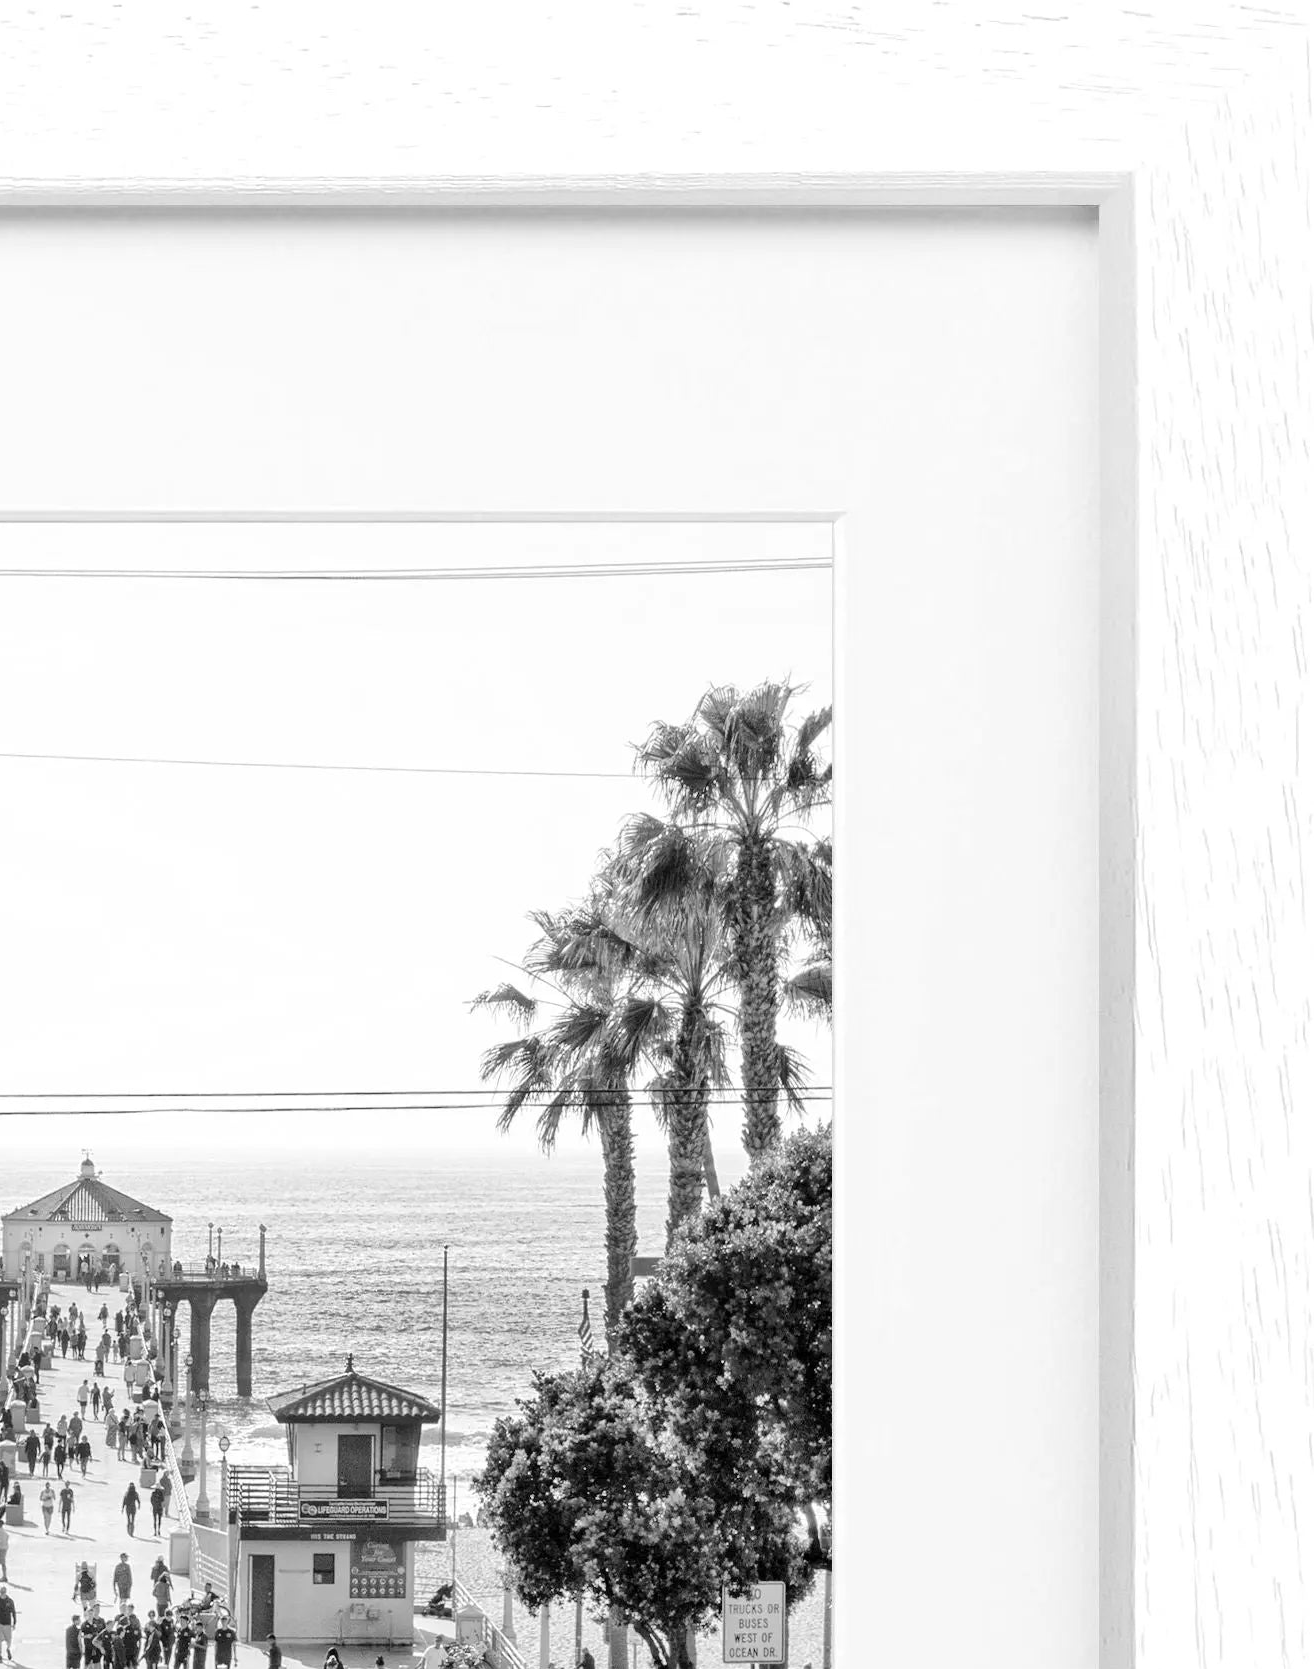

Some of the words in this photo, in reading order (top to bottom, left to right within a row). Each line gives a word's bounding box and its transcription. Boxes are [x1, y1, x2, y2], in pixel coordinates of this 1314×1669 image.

[317, 1506, 350, 1514] LIFEGUARD
[350, 1506, 387, 1514] OPERATIONS
[728, 1604, 763, 1615] TRUCKS
[767, 1603, 780, 1614] OR
[738, 1618, 769, 1629] BUSES
[734, 1633, 757, 1644] WEST
[761, 1632, 773, 1643] OF
[729, 1647, 759, 1658] OCEAN
